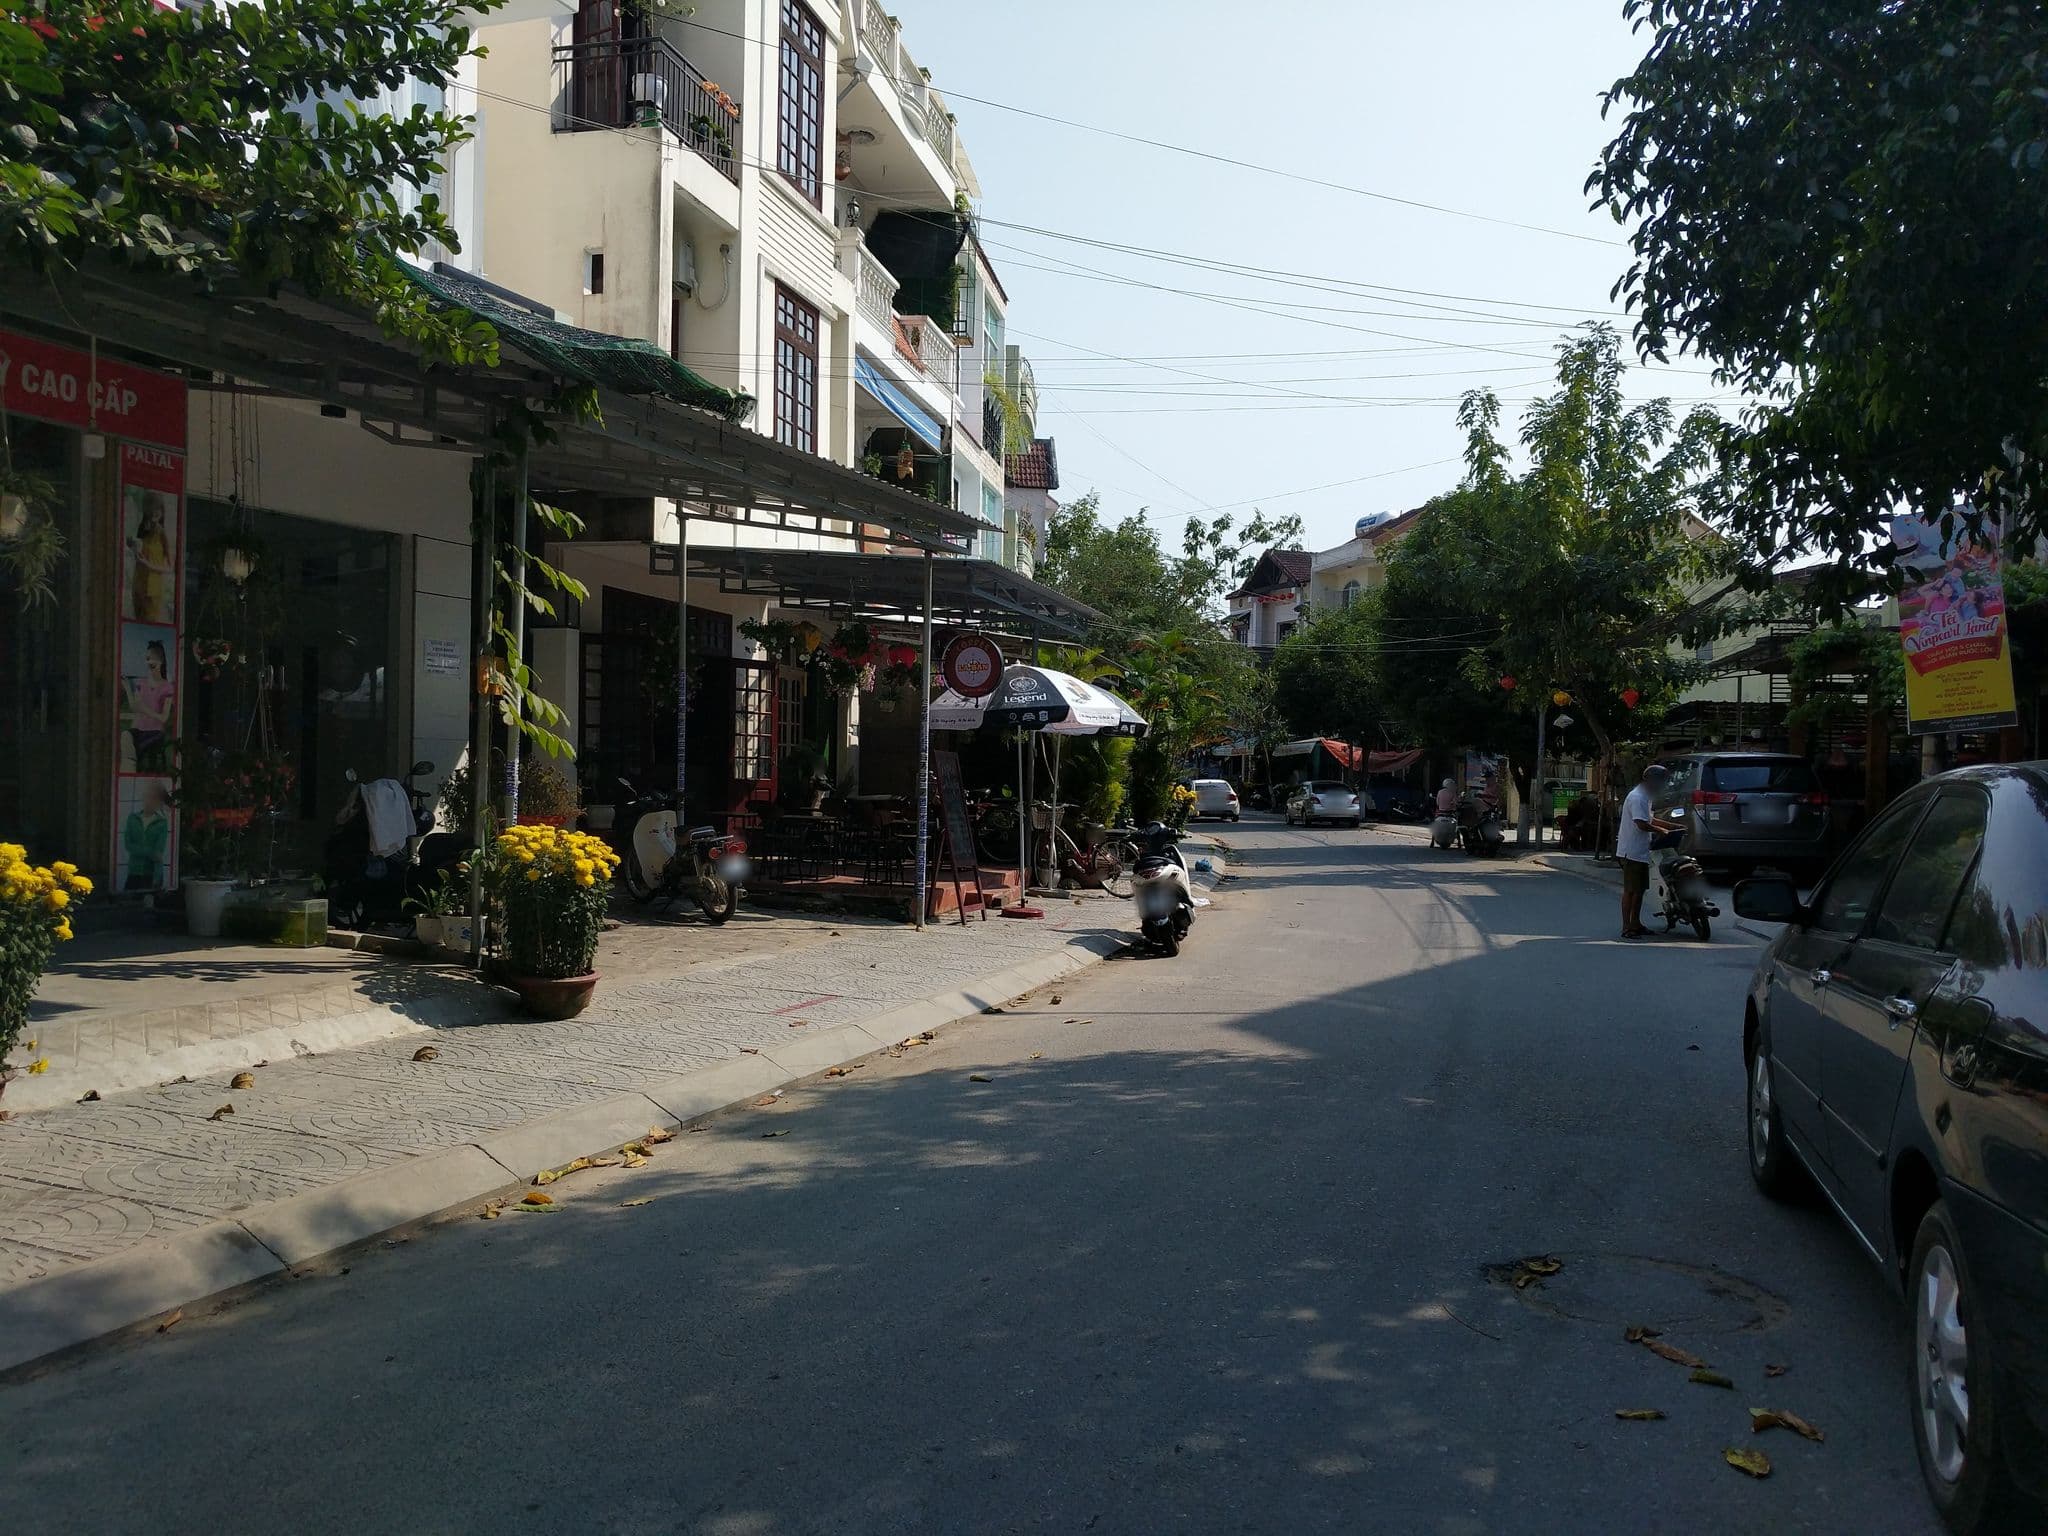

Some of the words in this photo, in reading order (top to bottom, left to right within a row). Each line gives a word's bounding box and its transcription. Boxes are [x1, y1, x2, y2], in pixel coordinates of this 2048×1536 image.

[21, 364, 77, 402] CAO
[126, 447, 175, 470] PALTAL
[1905, 623, 1960, 651] Vinpearl
[1965, 616, 1999, 636] Land
[1004, 693, 1047, 704] Legend
